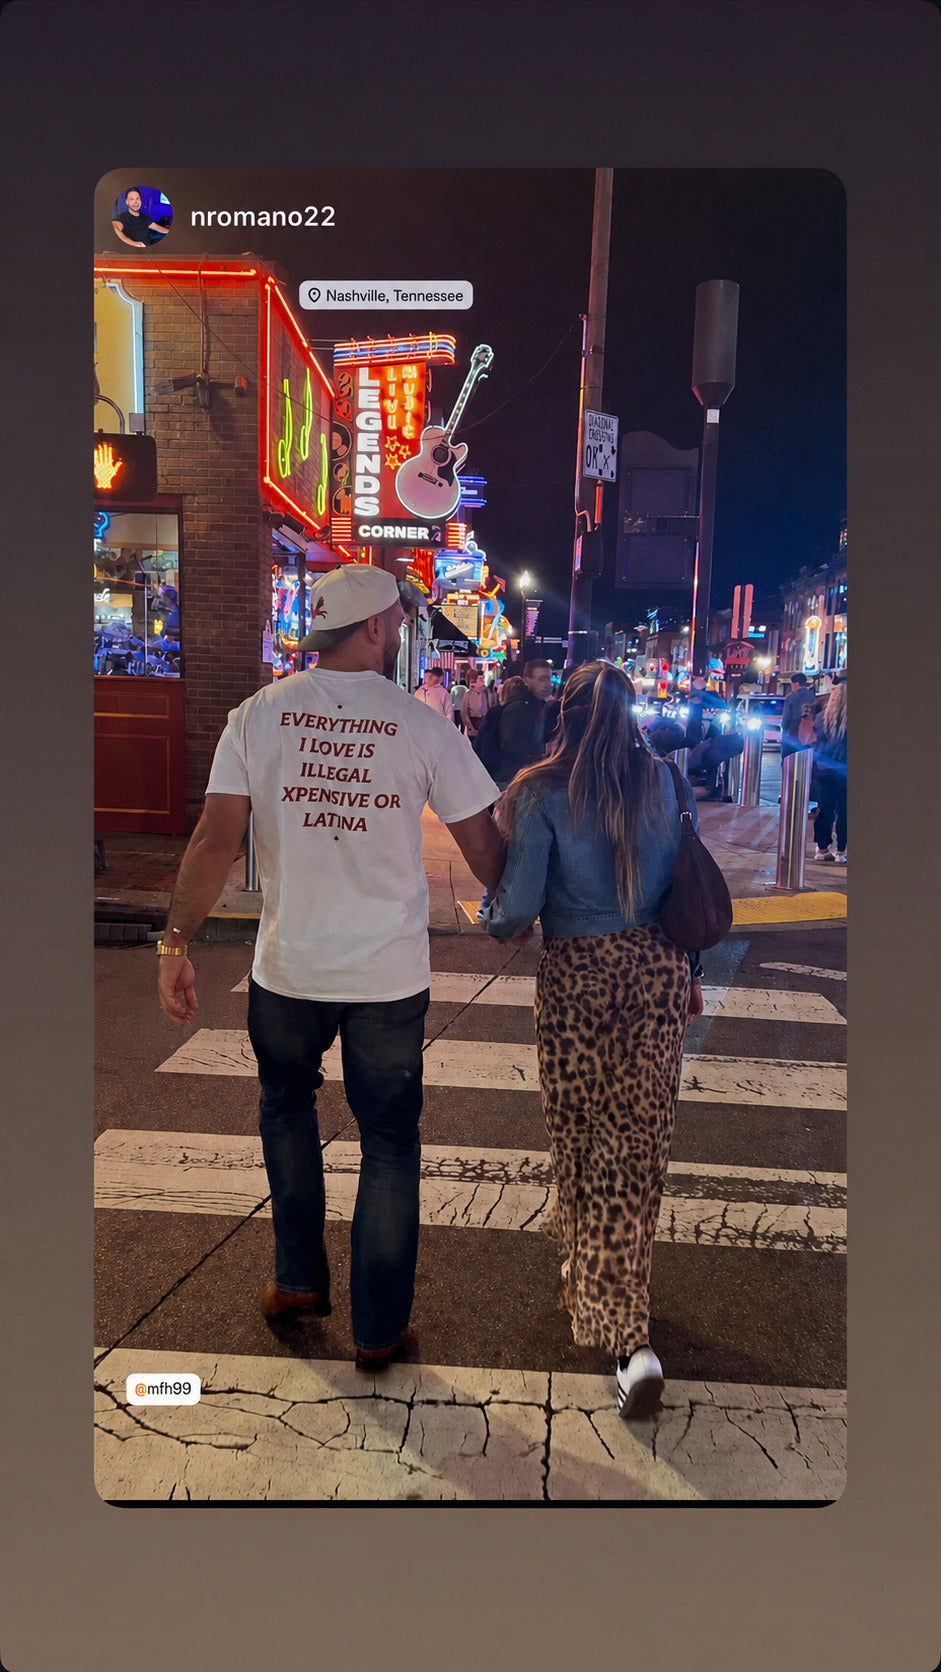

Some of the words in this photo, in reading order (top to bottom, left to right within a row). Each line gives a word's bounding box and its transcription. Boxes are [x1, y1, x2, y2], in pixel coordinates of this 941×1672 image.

[354, 367, 382, 517] LEGENDS
[358, 525, 430, 539] CORNER
[280, 712, 398, 736] EVERYTHING
[299, 737, 307, 752] I
[309, 738, 356, 758] LOVE
[357, 743, 375, 758] IS
[300, 762, 372, 783] ILLEGAL
[281, 786, 370, 808] XPENSIVE
[374, 794, 401, 809] OR
[302, 812, 368, 832] LATINA
